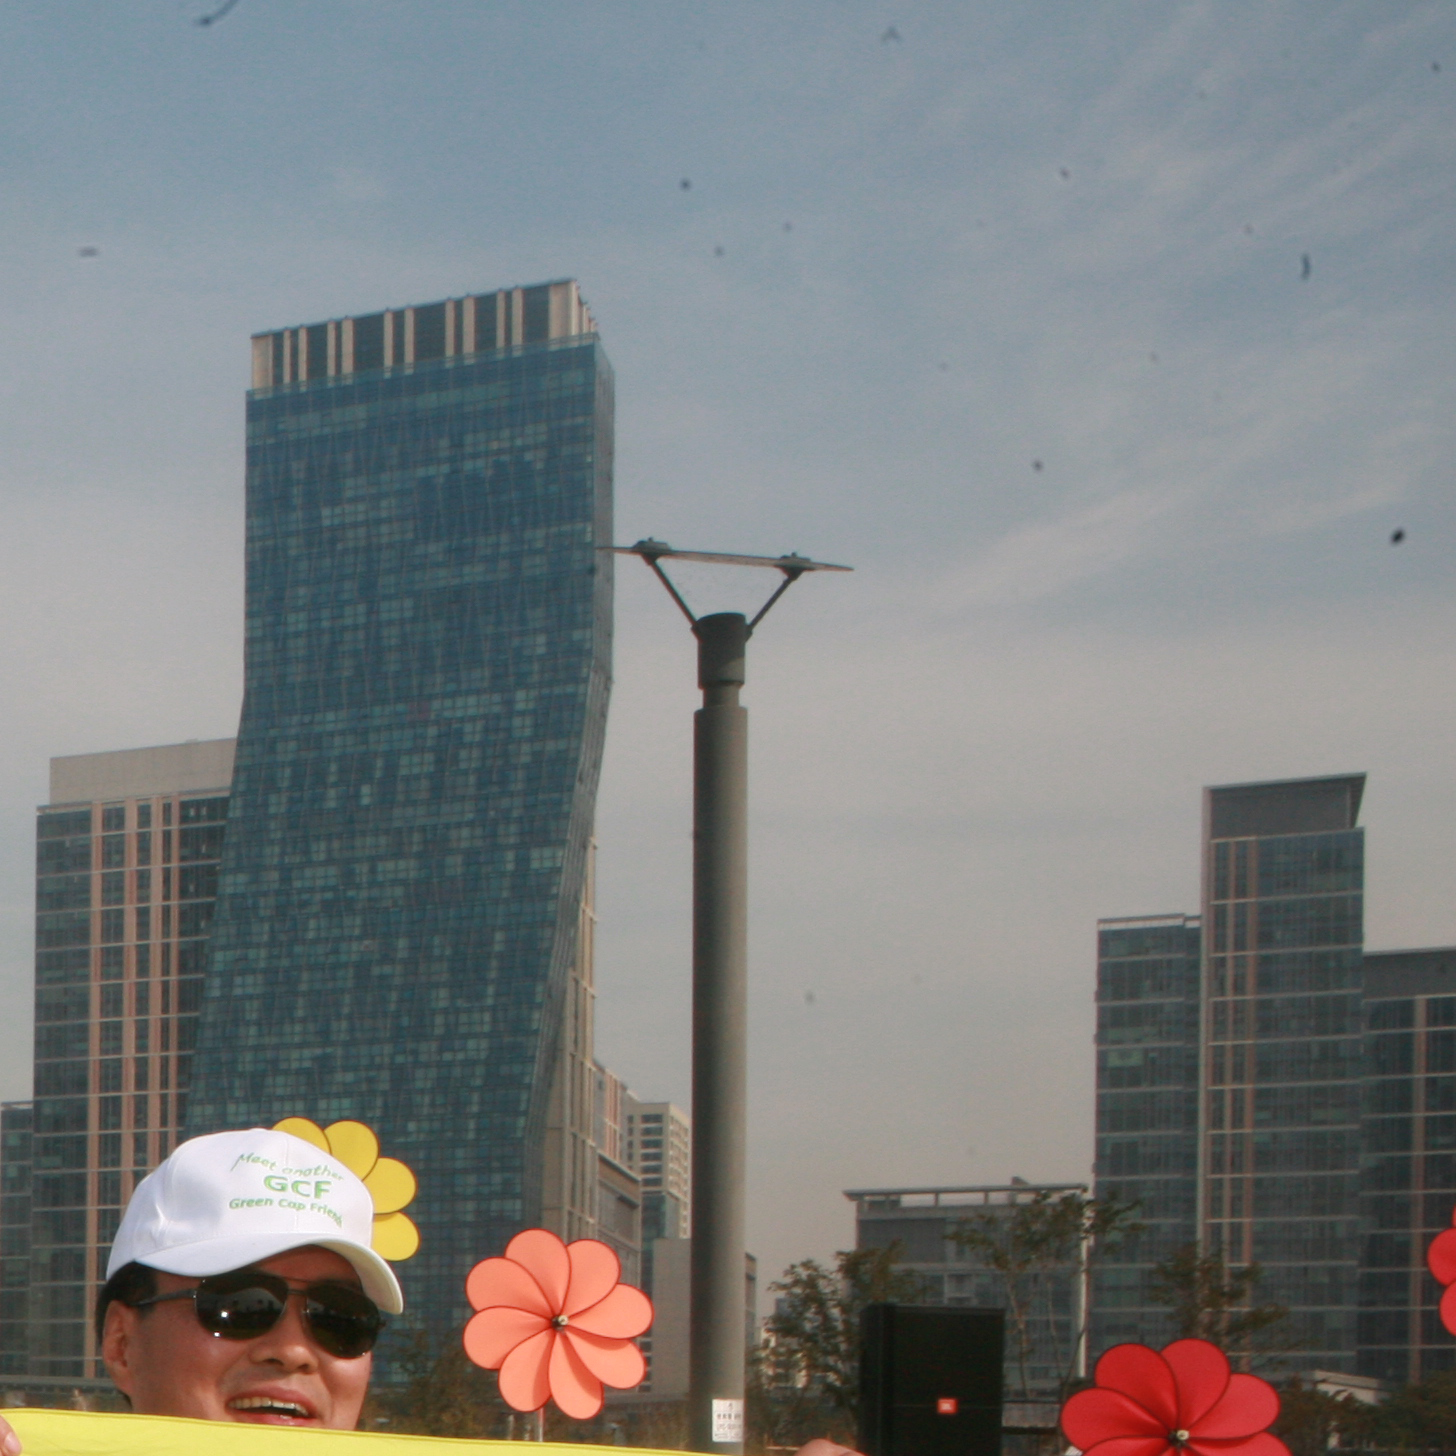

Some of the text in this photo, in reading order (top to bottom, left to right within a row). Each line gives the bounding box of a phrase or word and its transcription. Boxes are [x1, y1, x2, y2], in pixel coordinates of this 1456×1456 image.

[263, 1175, 332, 1199] GCF
[229, 1198, 273, 1210] Green
[278, 1198, 306, 1211] Cap
